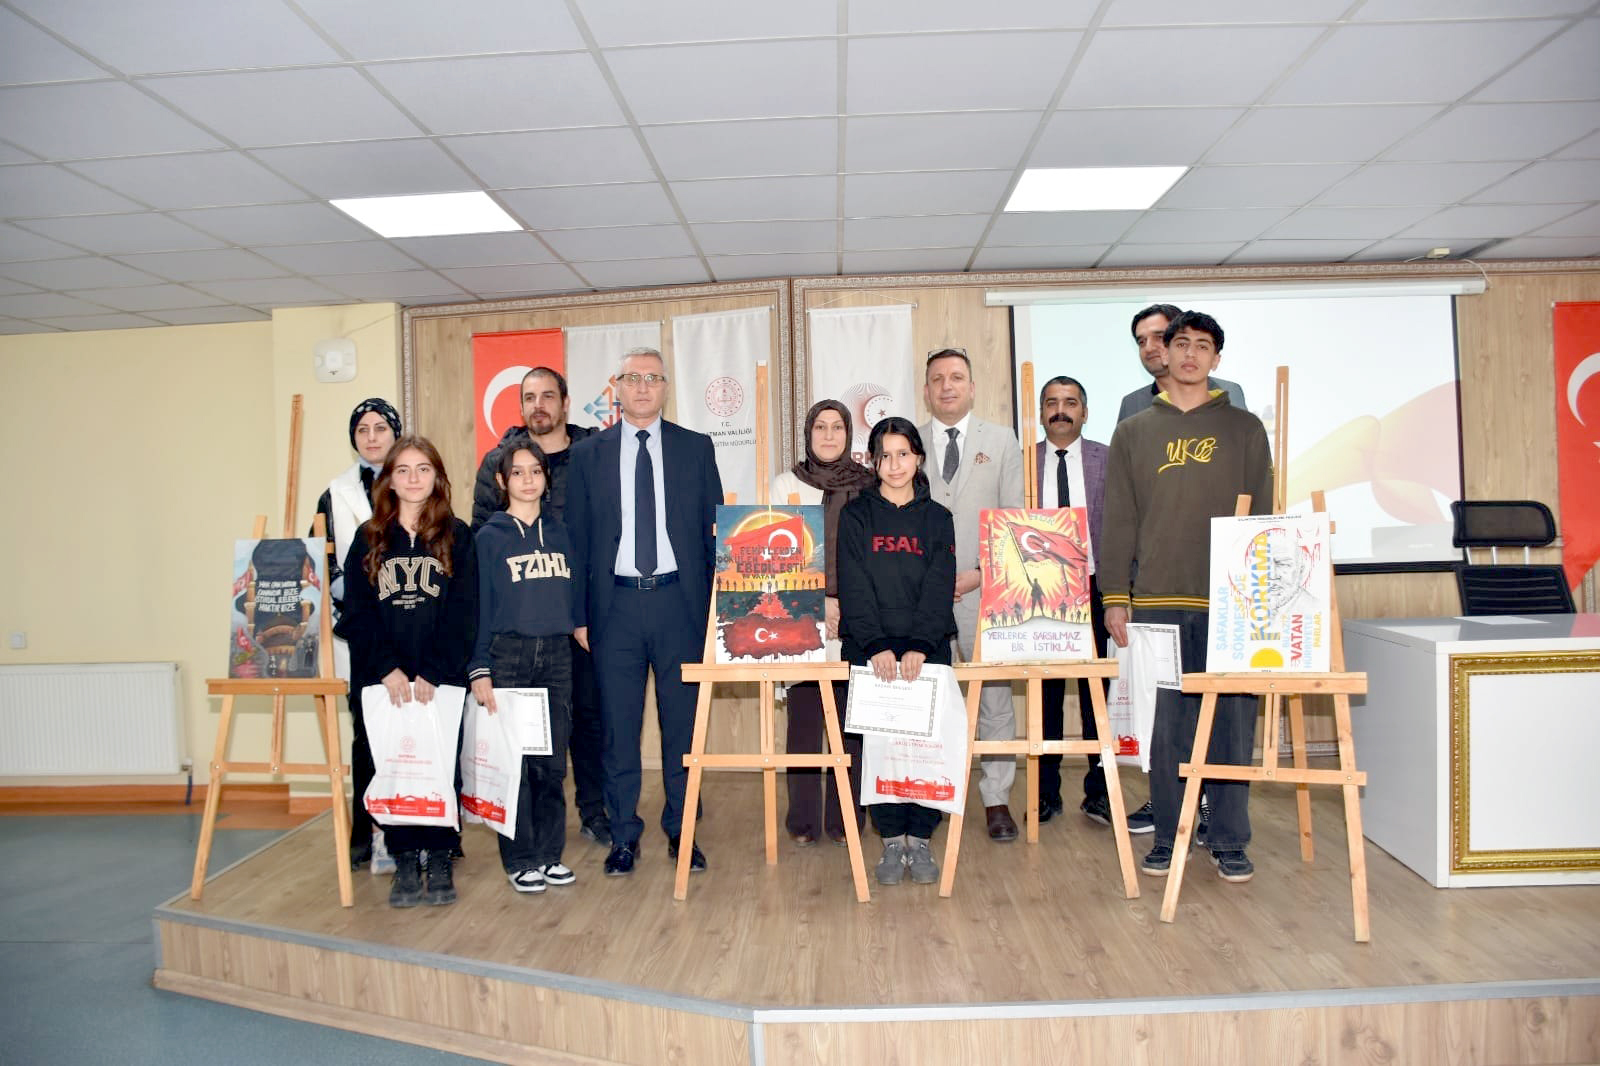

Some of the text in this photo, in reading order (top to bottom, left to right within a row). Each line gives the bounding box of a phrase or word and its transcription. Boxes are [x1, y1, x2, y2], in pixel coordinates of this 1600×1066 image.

[872, 536, 924, 555] FSAL
[378, 556, 444, 601] NYC
[506, 549, 571, 583] FZİHL
[1250, 531, 1280, 641] KORKMA
[1032, 631, 1082, 641] SARSILMAZ
[1290, 614, 1303, 662] VATAN
